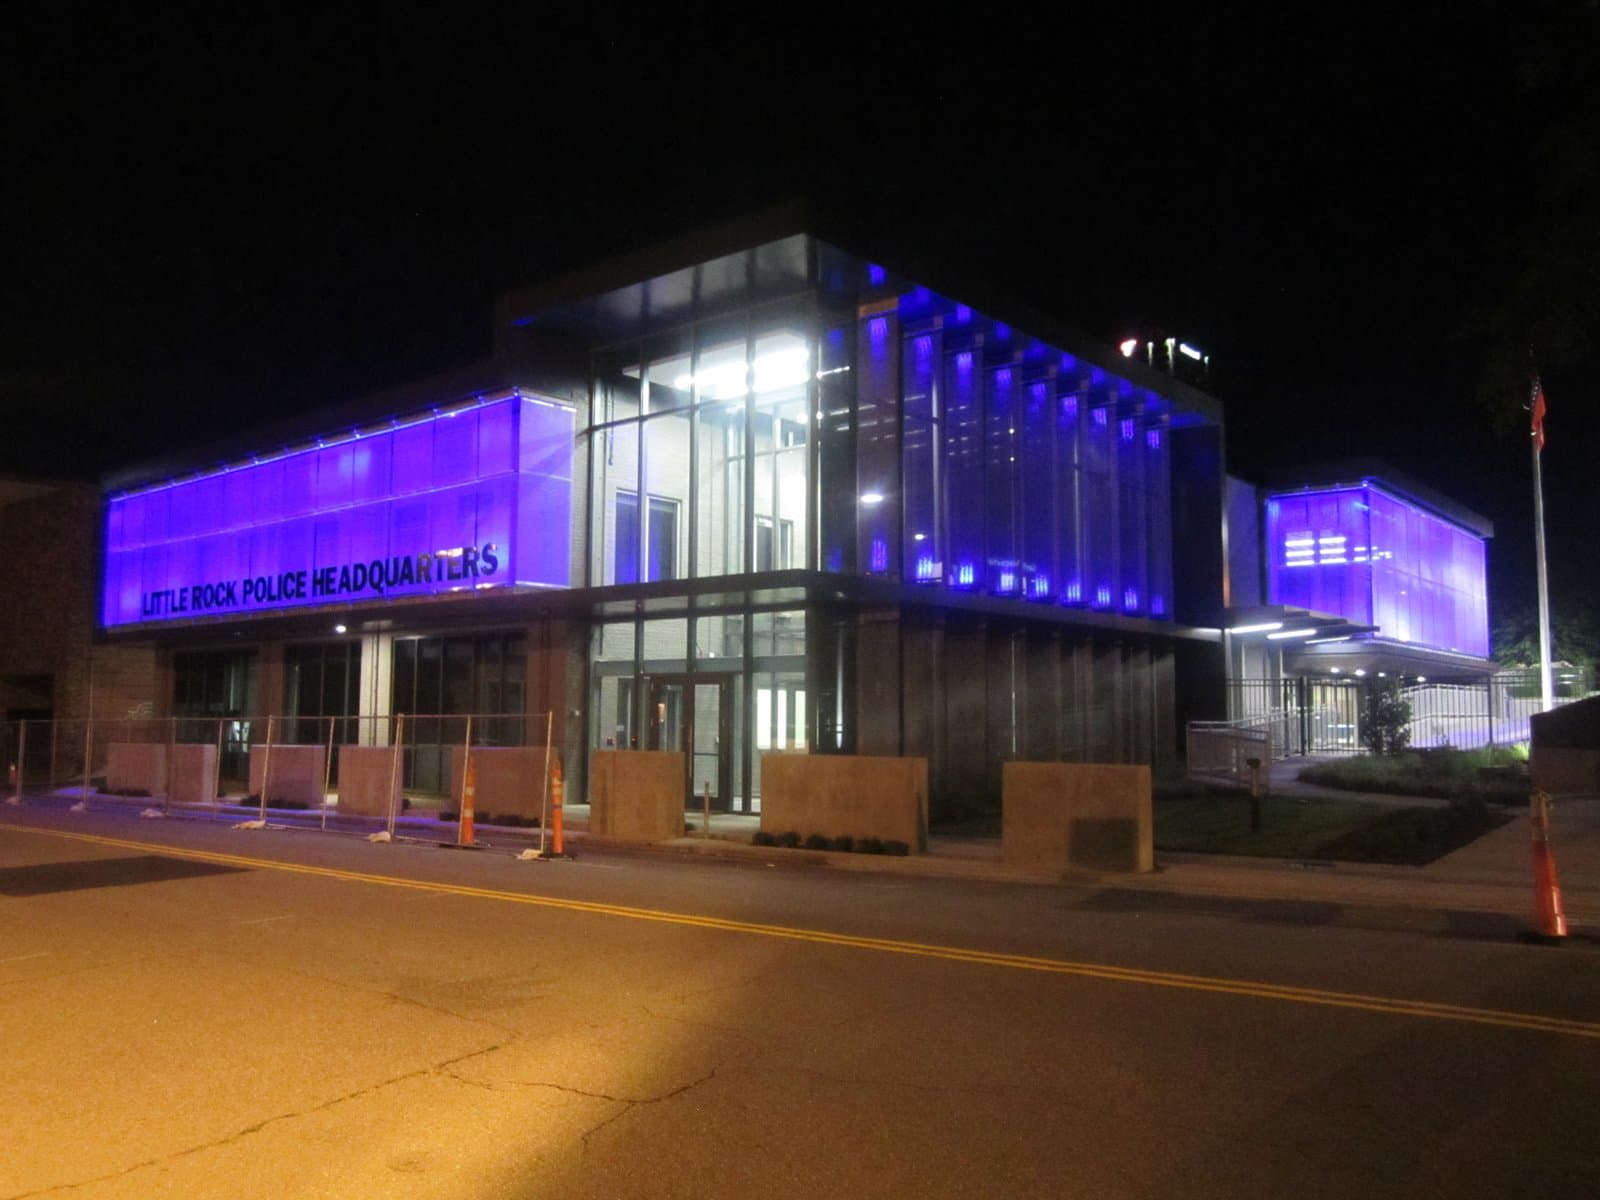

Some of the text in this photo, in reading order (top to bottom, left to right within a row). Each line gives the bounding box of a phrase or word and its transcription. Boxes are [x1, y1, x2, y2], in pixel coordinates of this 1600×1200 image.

[143, 543, 498, 616] LITTLE ROCK POLICE HEADQUARTERS
